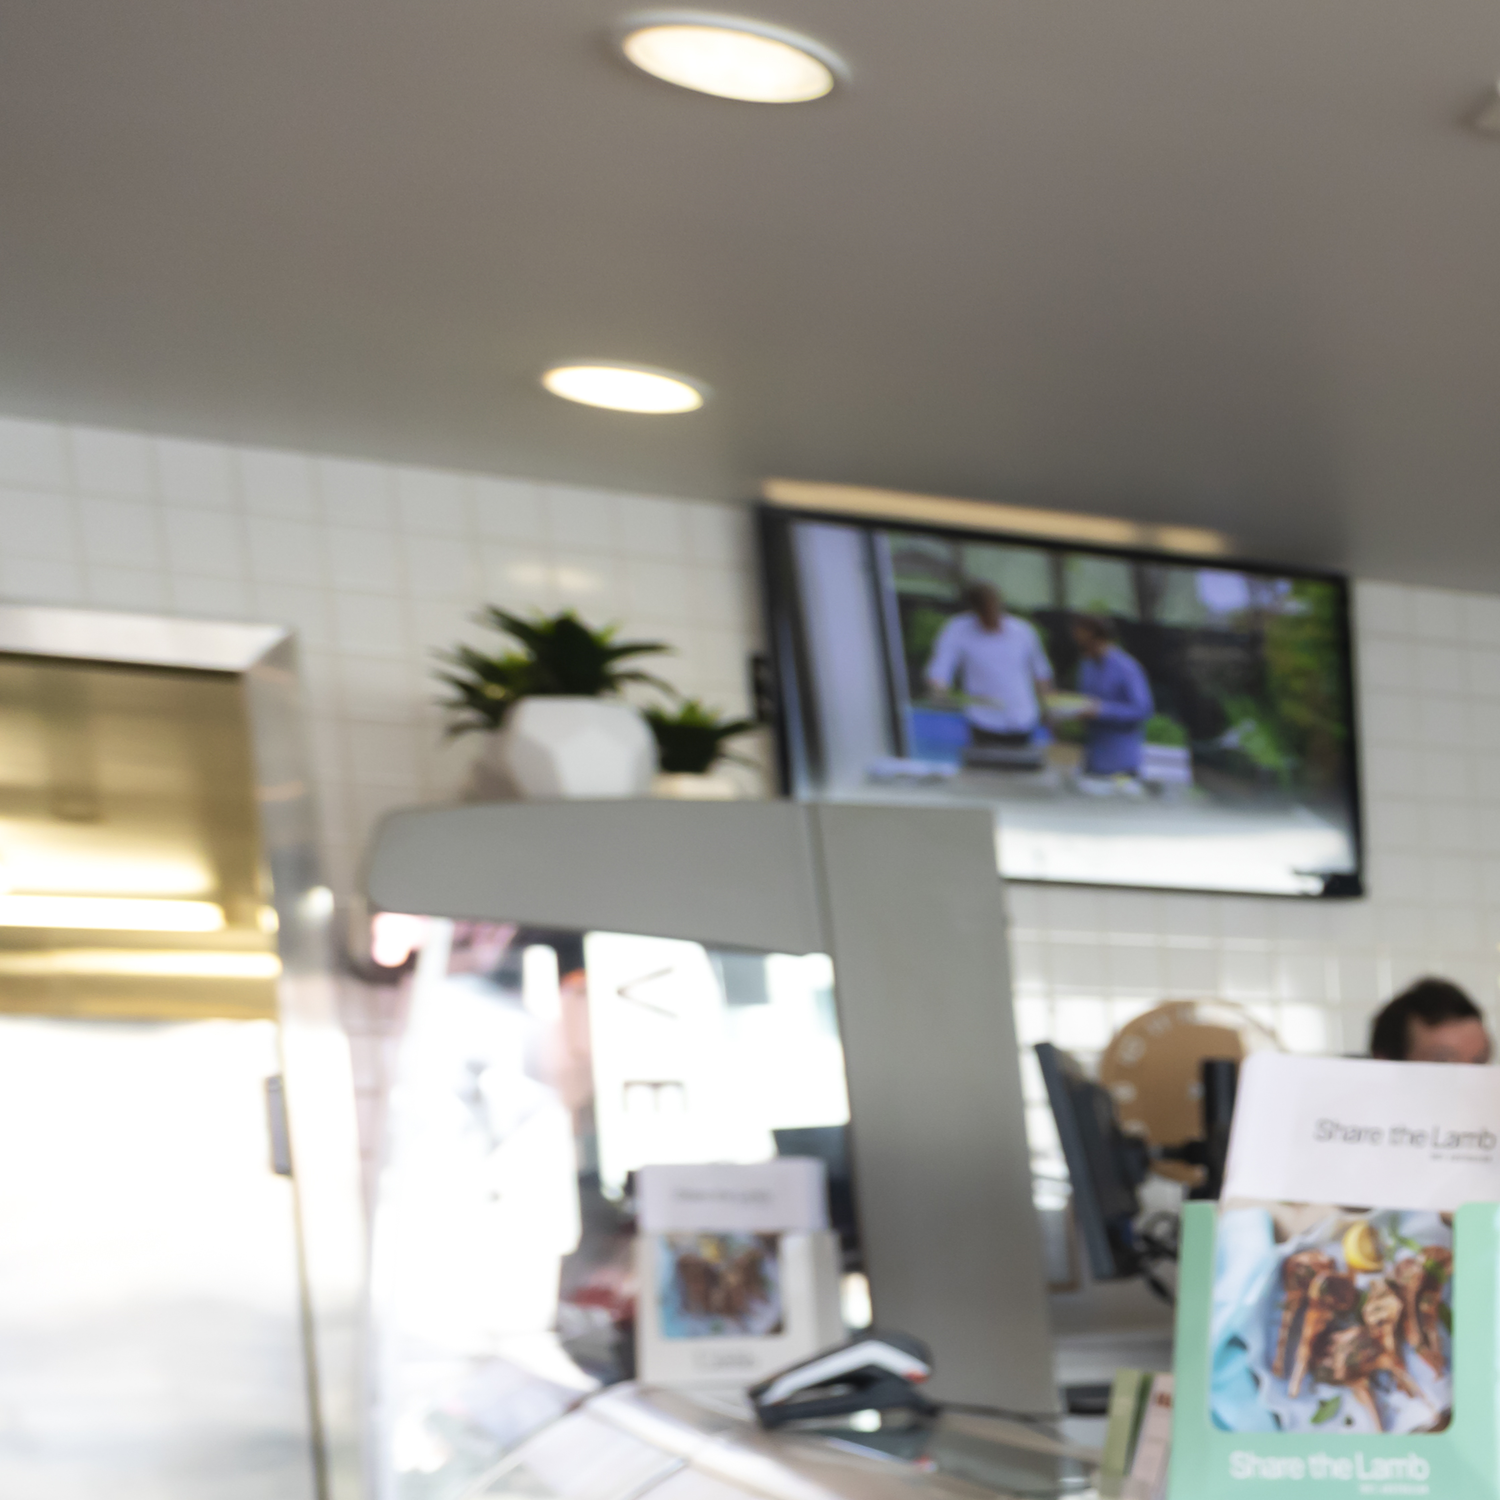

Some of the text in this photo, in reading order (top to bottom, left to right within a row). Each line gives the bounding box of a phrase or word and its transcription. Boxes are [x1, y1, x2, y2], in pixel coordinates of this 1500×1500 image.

[1313, 1117, 1496, 1149] Share the Lamb
[1229, 1450, 1430, 1481] Share the Lamb
